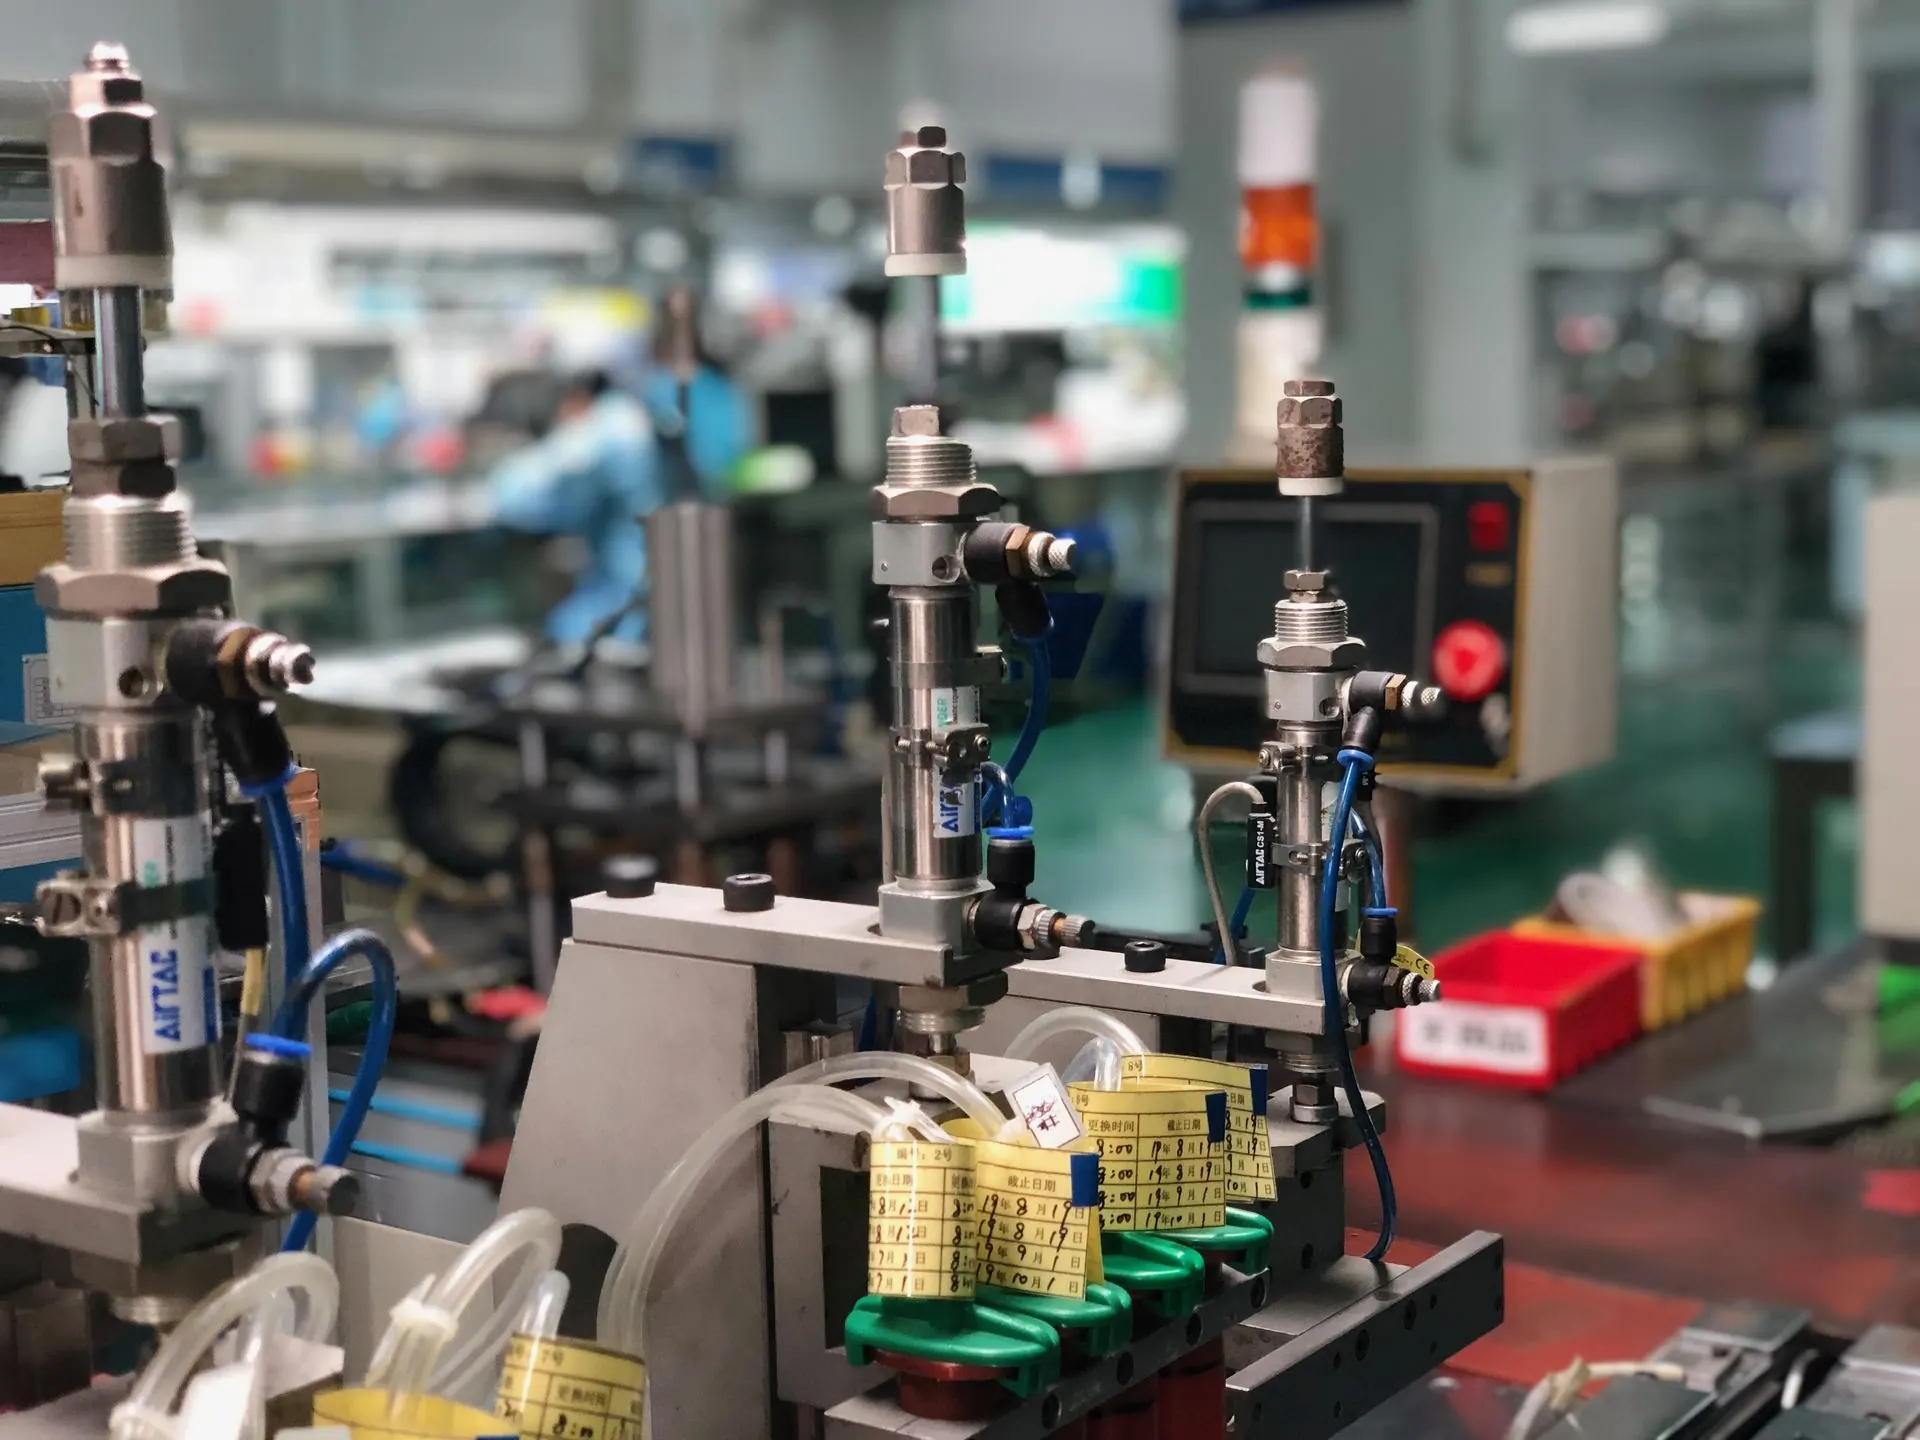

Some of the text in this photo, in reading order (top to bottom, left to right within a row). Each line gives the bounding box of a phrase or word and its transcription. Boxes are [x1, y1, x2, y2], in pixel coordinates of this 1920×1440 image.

[1256, 821, 1265, 848] CS1-M
[1088, 1119, 1135, 1132] 更换时间
[1167, 1119, 1201, 1131] 截止日期
[1007, 1175, 1057, 1193] 截止日期
